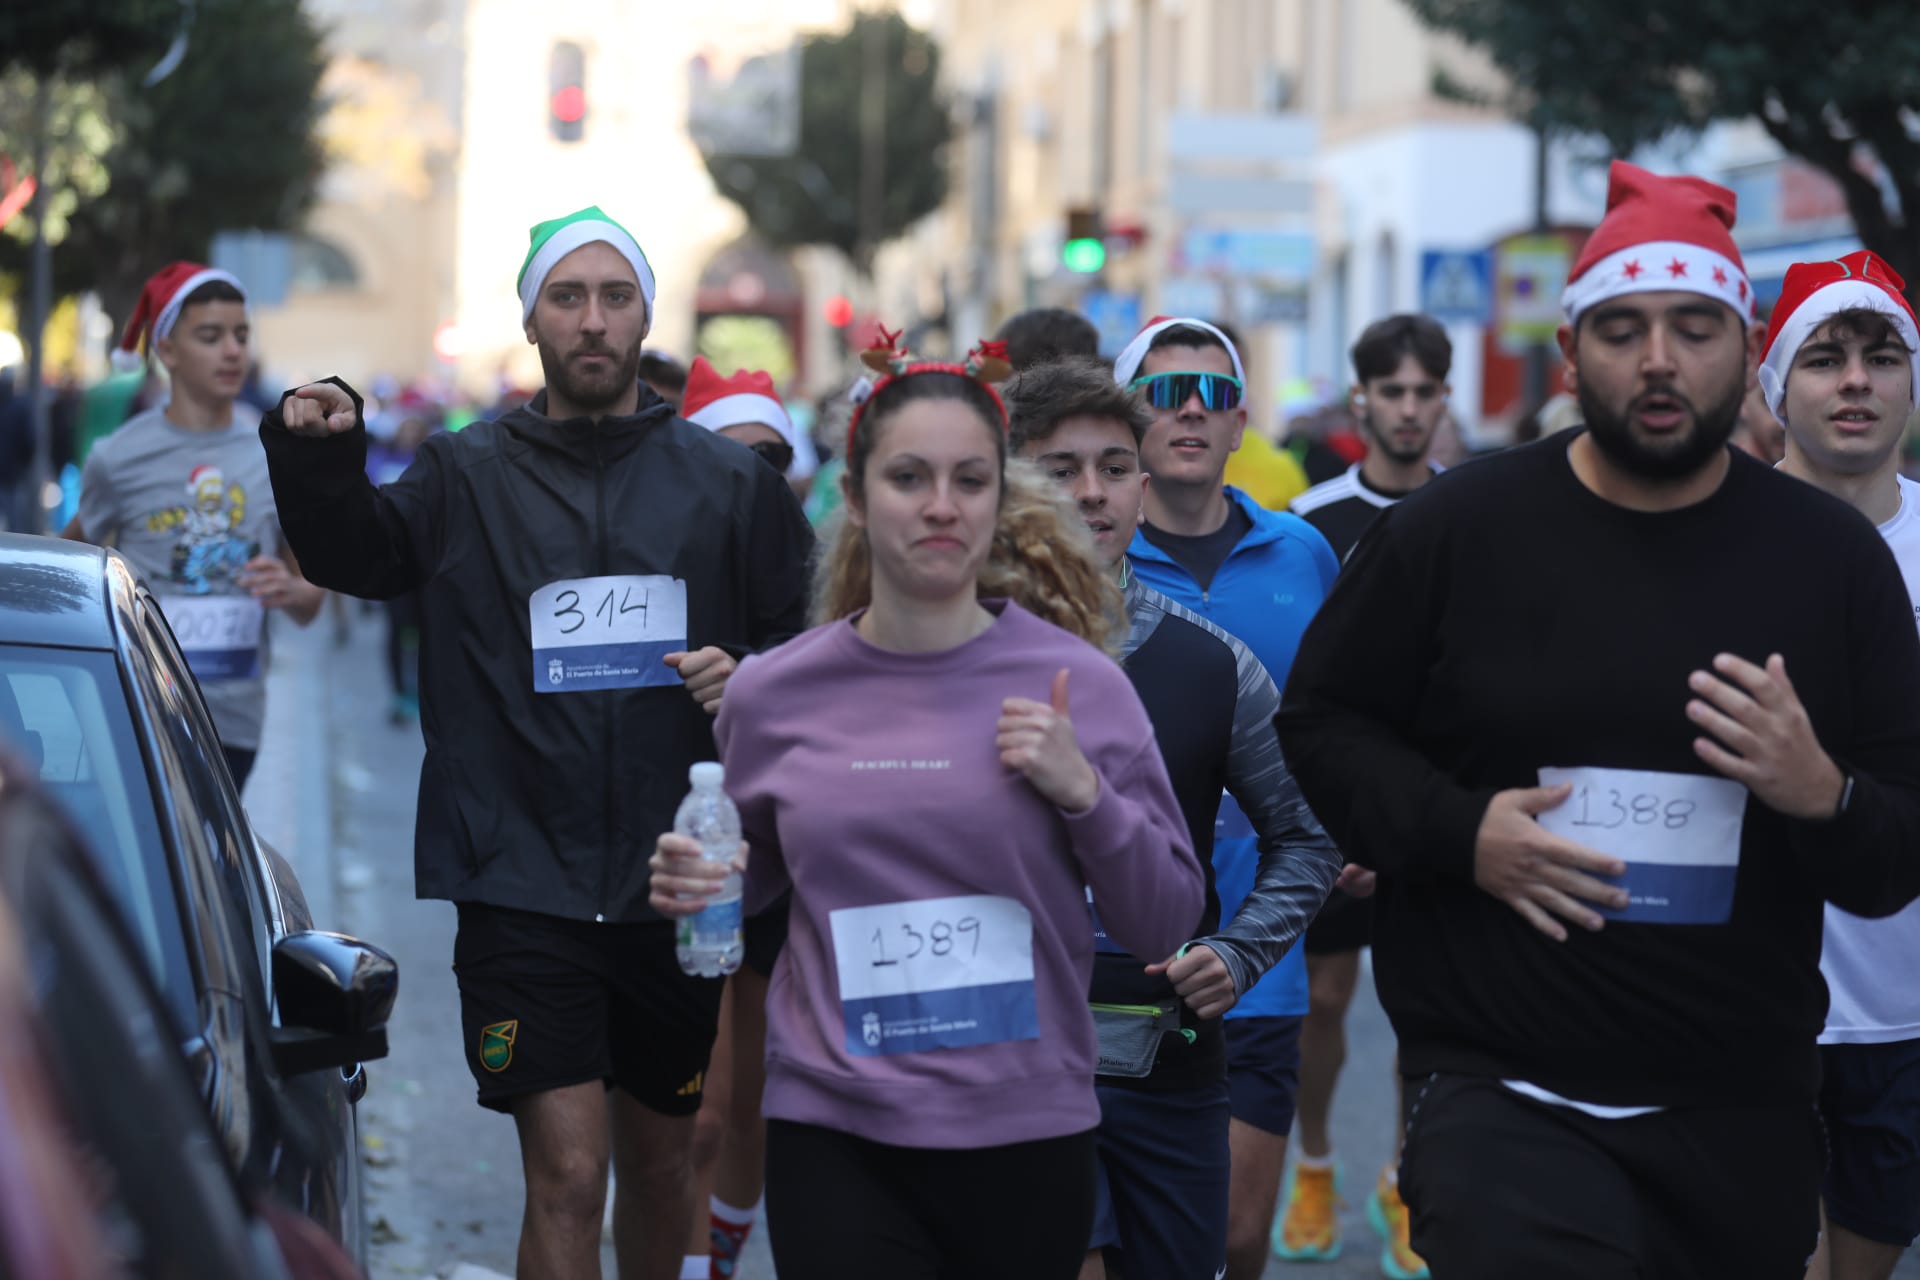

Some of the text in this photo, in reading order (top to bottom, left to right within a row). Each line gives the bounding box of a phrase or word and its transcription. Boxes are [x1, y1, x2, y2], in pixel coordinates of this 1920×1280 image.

[554, 586, 649, 634] 314
[1571, 786, 1697, 829] 1388
[871, 916, 981, 967] 1389
